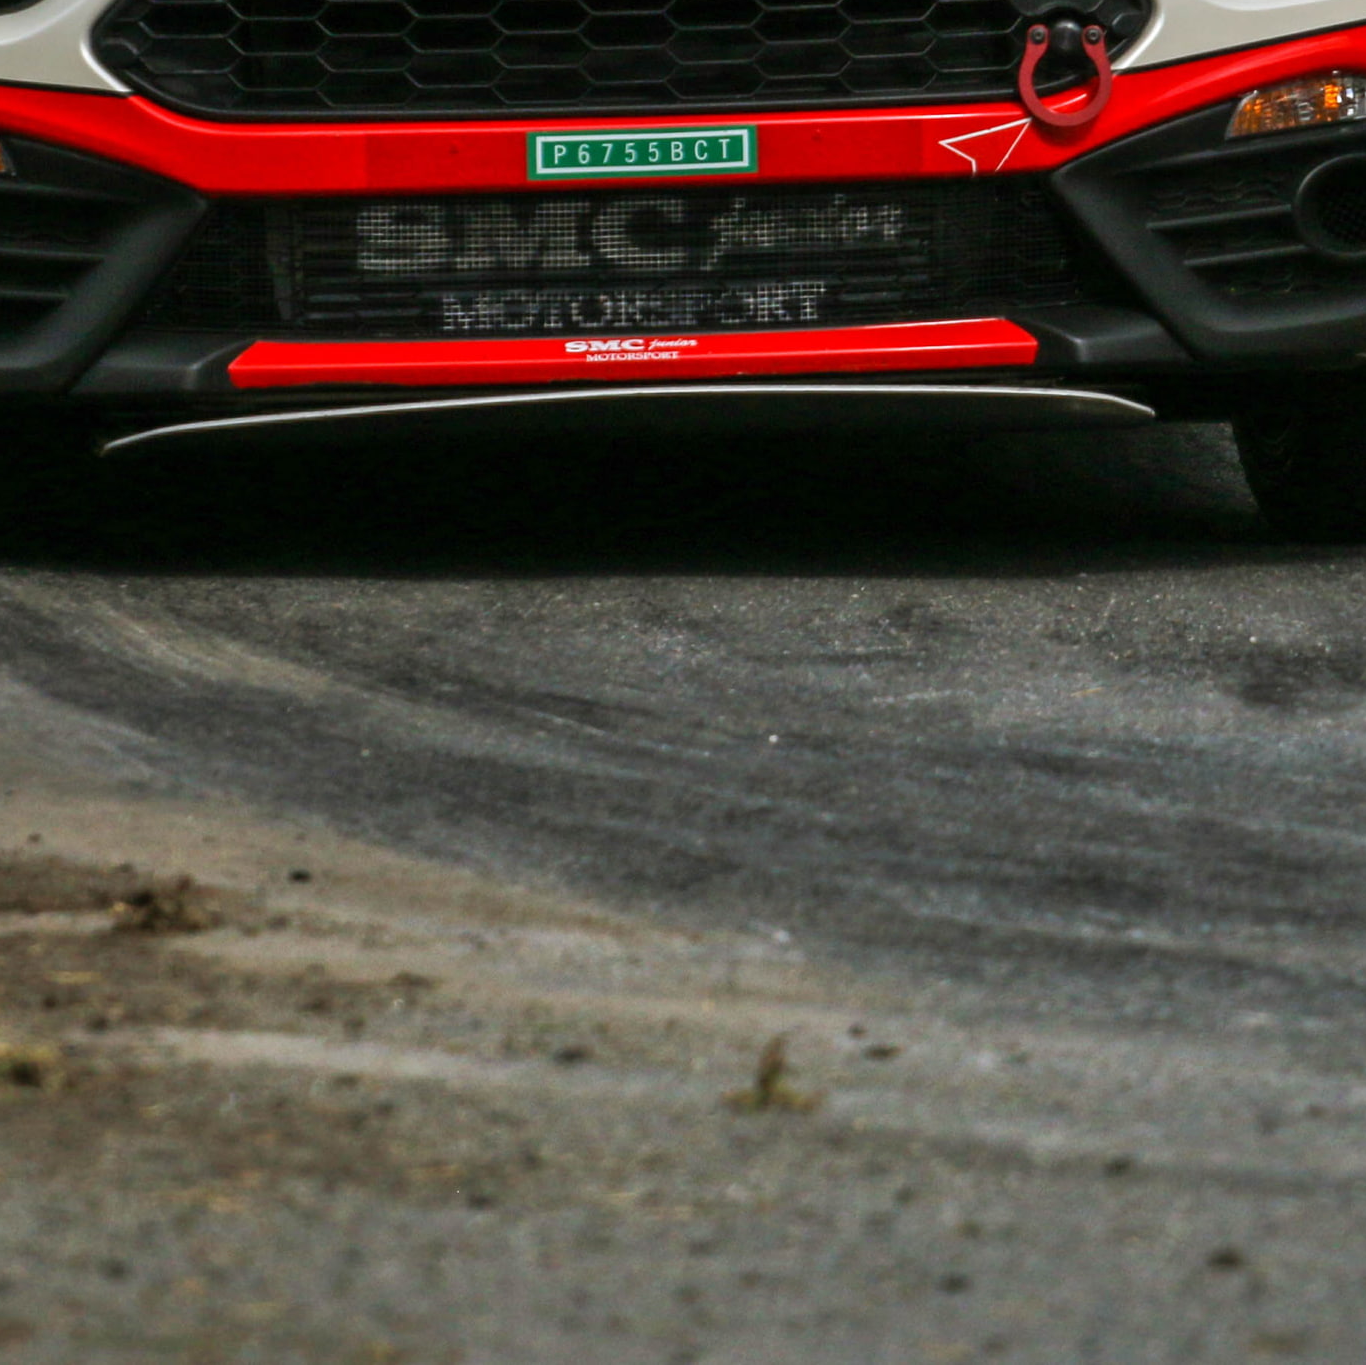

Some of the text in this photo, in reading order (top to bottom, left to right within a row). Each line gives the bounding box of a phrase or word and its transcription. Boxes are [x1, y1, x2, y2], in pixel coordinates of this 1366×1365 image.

[553, 138, 731, 165] P6755BCT
[356, 198, 688, 271] SMC
[564, 338, 698, 353] SMC junior
[585, 351, 680, 362] MOTORSPORT
